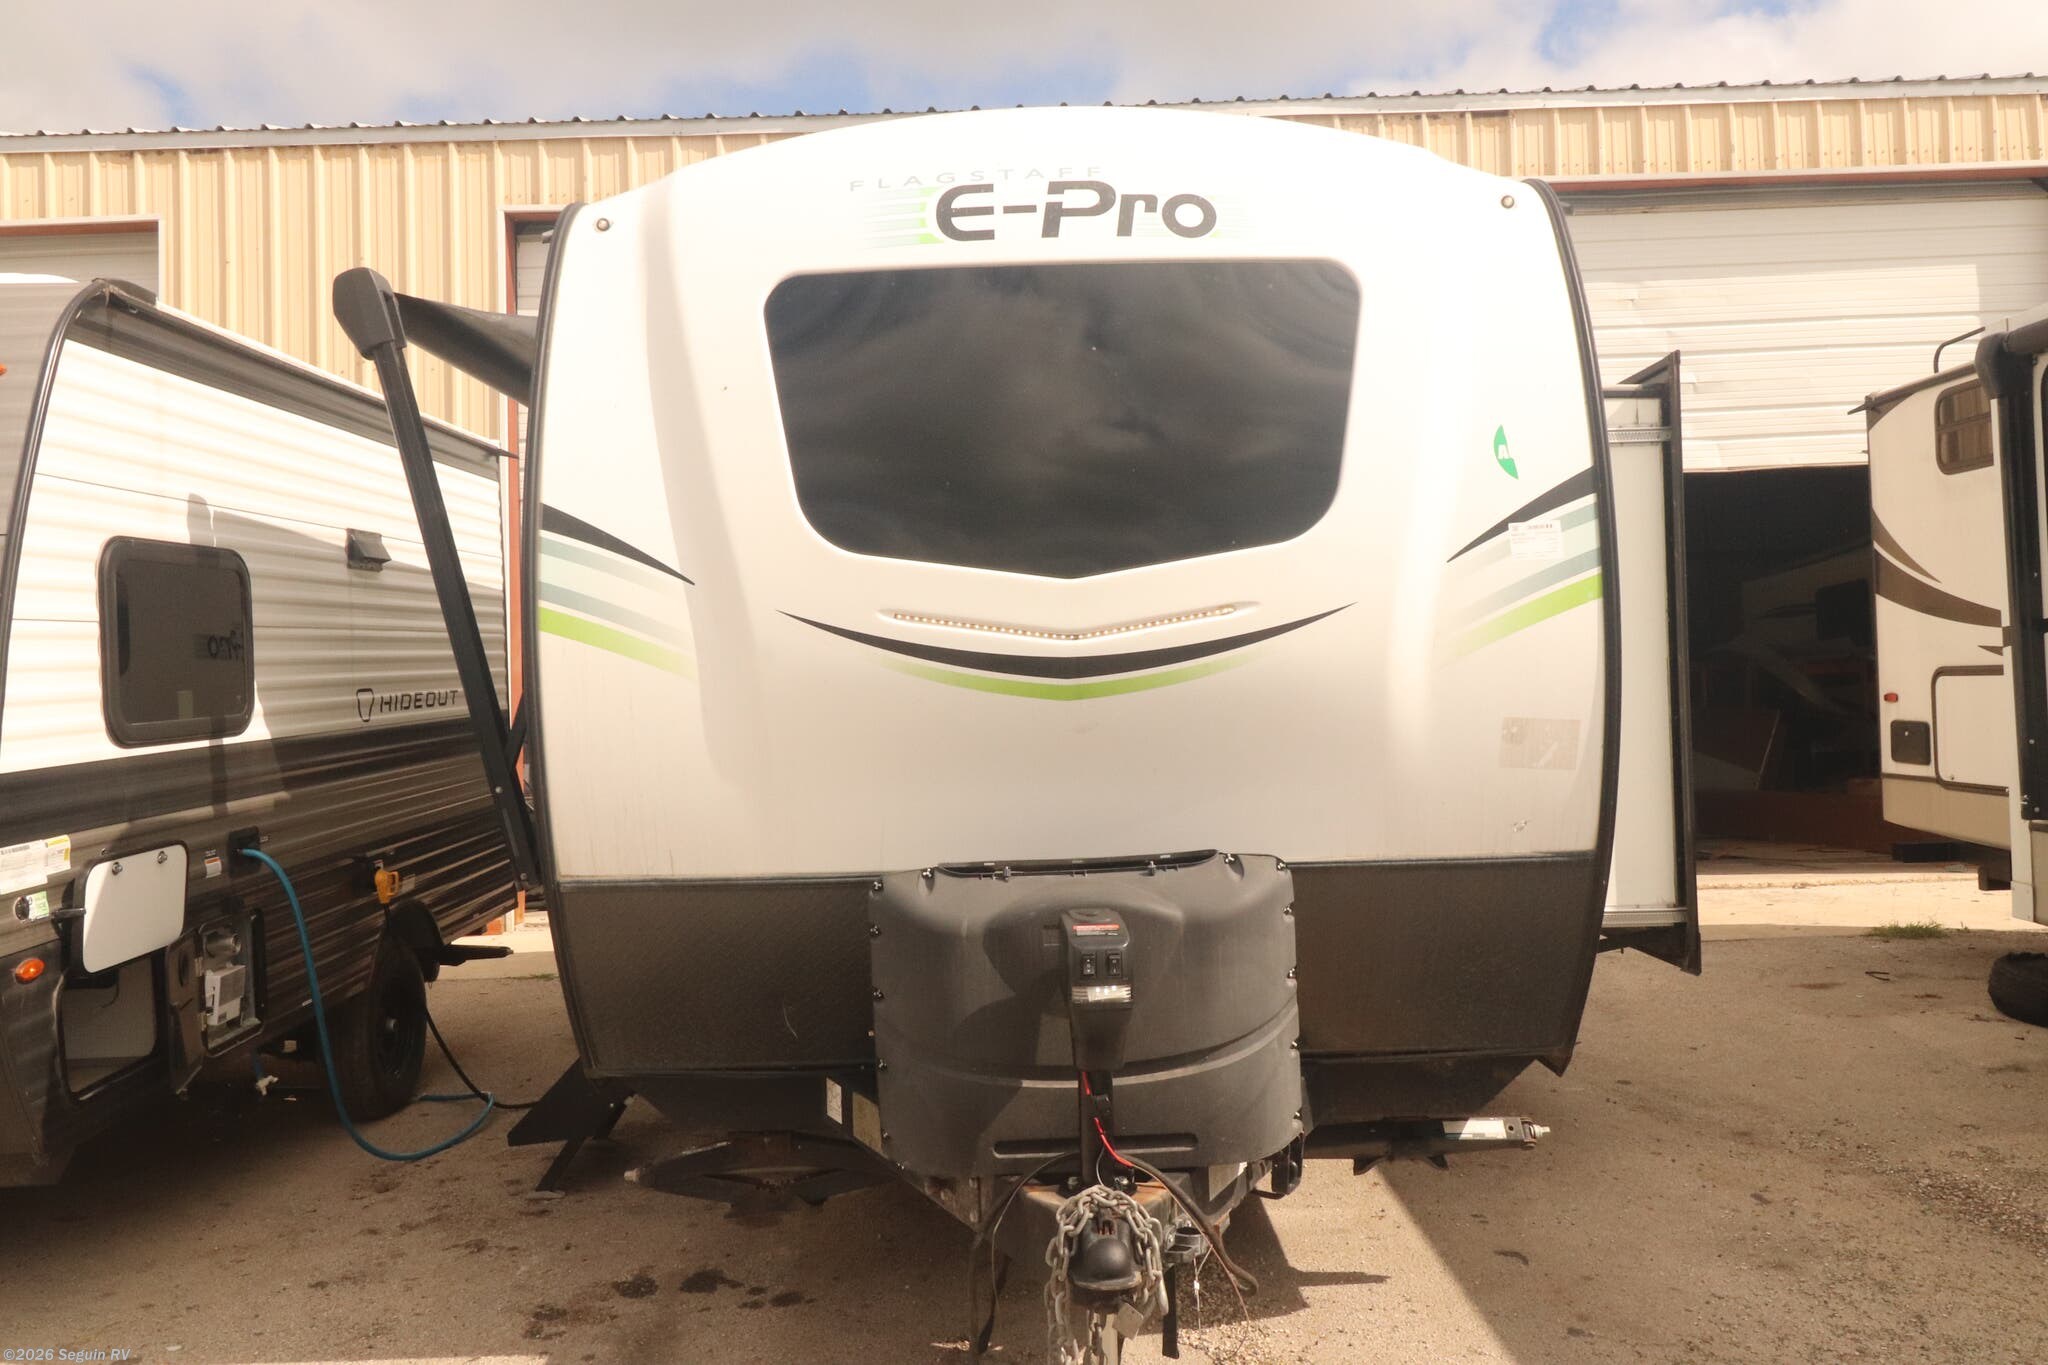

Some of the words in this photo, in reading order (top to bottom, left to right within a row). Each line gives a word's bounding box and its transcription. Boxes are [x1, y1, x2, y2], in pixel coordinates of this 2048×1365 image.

[849, 167, 1103, 192] FLAGSTAFF
[936, 180, 1217, 242] E-Pro
[380, 690, 459, 712] HIDEOUT
